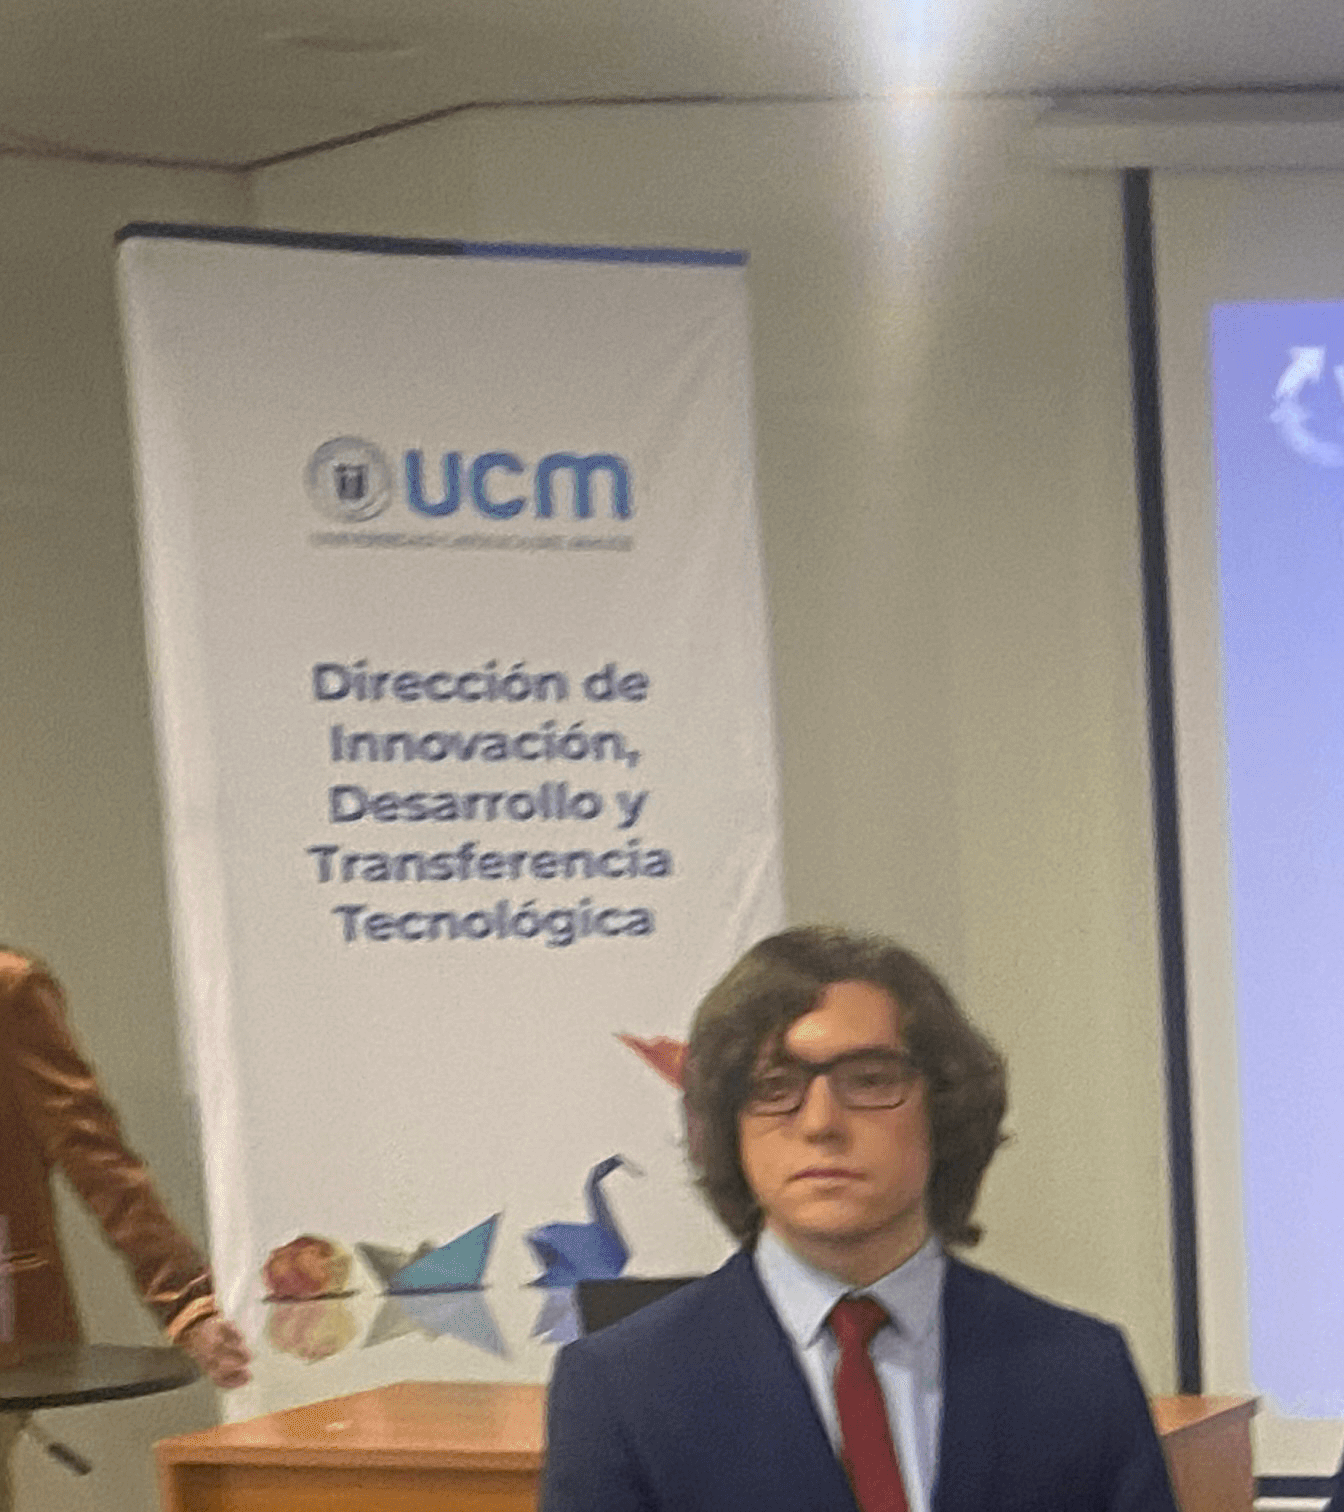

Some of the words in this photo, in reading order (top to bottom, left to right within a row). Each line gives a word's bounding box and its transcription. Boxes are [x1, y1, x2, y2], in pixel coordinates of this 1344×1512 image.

[311, 658, 569, 703] Dirección
[582, 661, 650, 703] de
[329, 720, 641, 769] Innovación,
[328, 781, 603, 824] Desarrollo
[616, 789, 650, 830] y
[306, 837, 673, 884] Transferencia
[331, 898, 656, 949] Tecnológica
